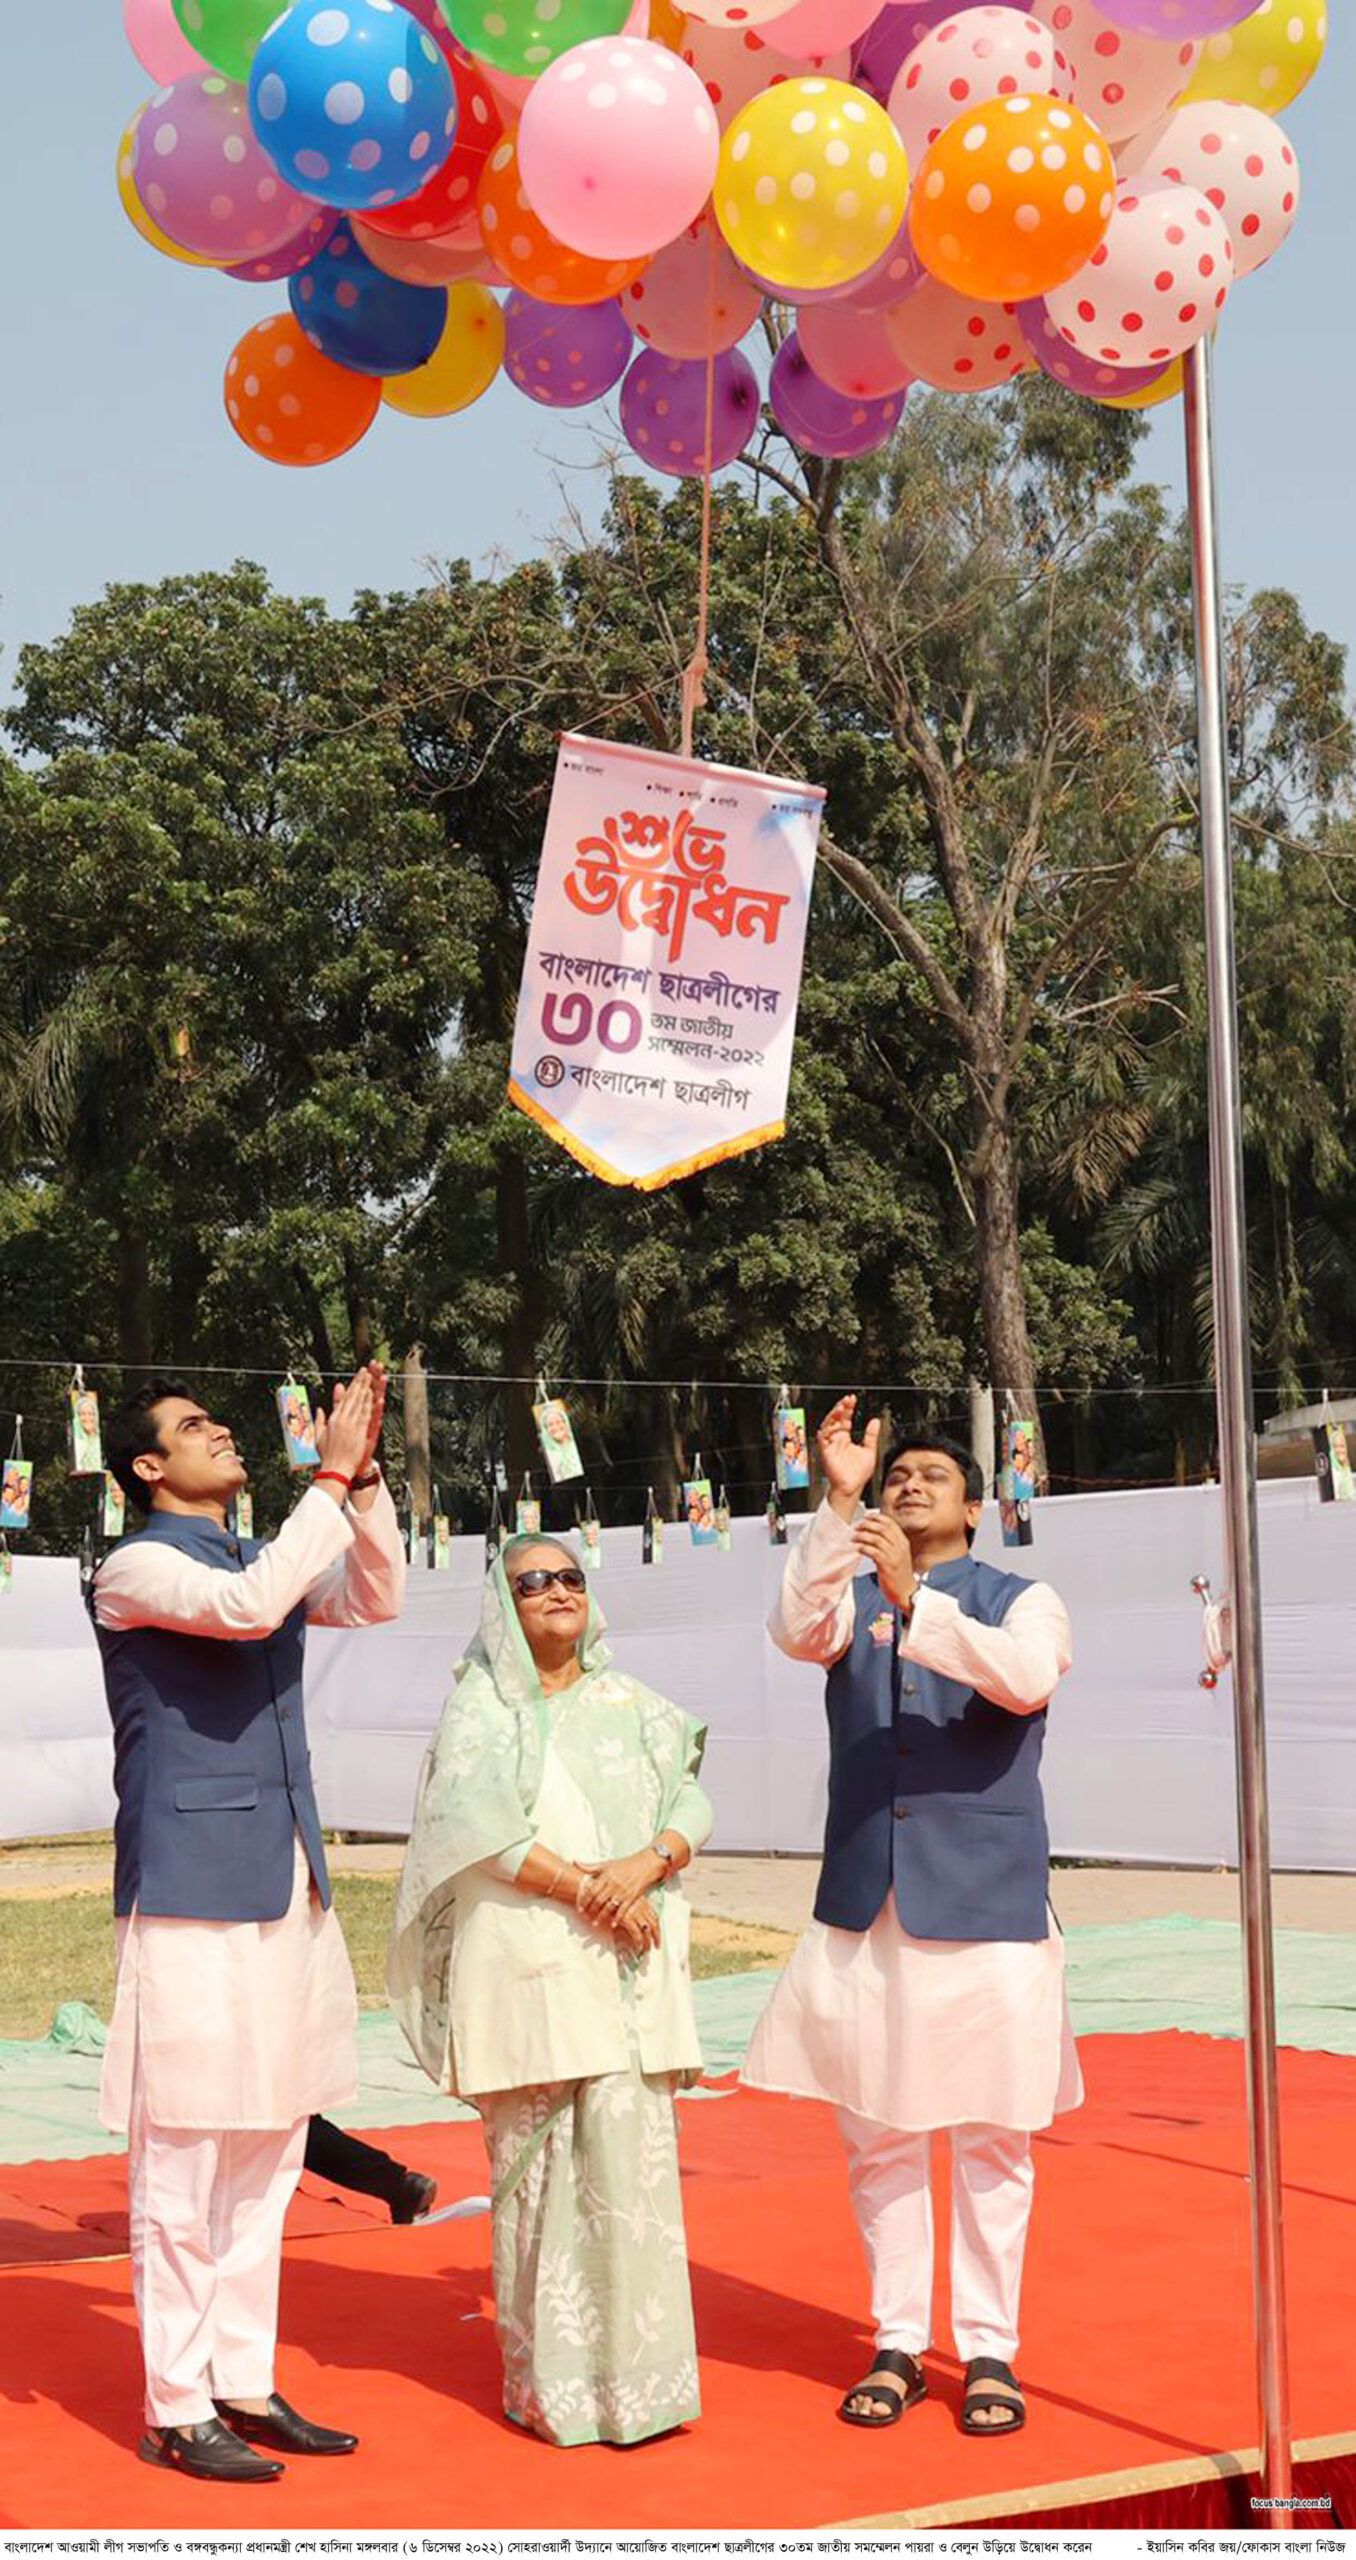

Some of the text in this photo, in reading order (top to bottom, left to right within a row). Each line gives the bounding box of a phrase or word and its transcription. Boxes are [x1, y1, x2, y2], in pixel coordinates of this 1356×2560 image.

[603, 809, 726, 880] শুভ
[563, 836, 791, 964] উদ্বোধন
[539, 951, 781, 1014] বাংলাদেশ ছাত্রলীগের
[540, 992, 643, 1054] ৩০
[647, 1036, 765, 1067] সম্মেলন-২০২২
[650, 1012, 734, 1040] তম জাতীয়
[570, 1064, 752, 1111] বাংলাদেশ ছাত্রলীগ
